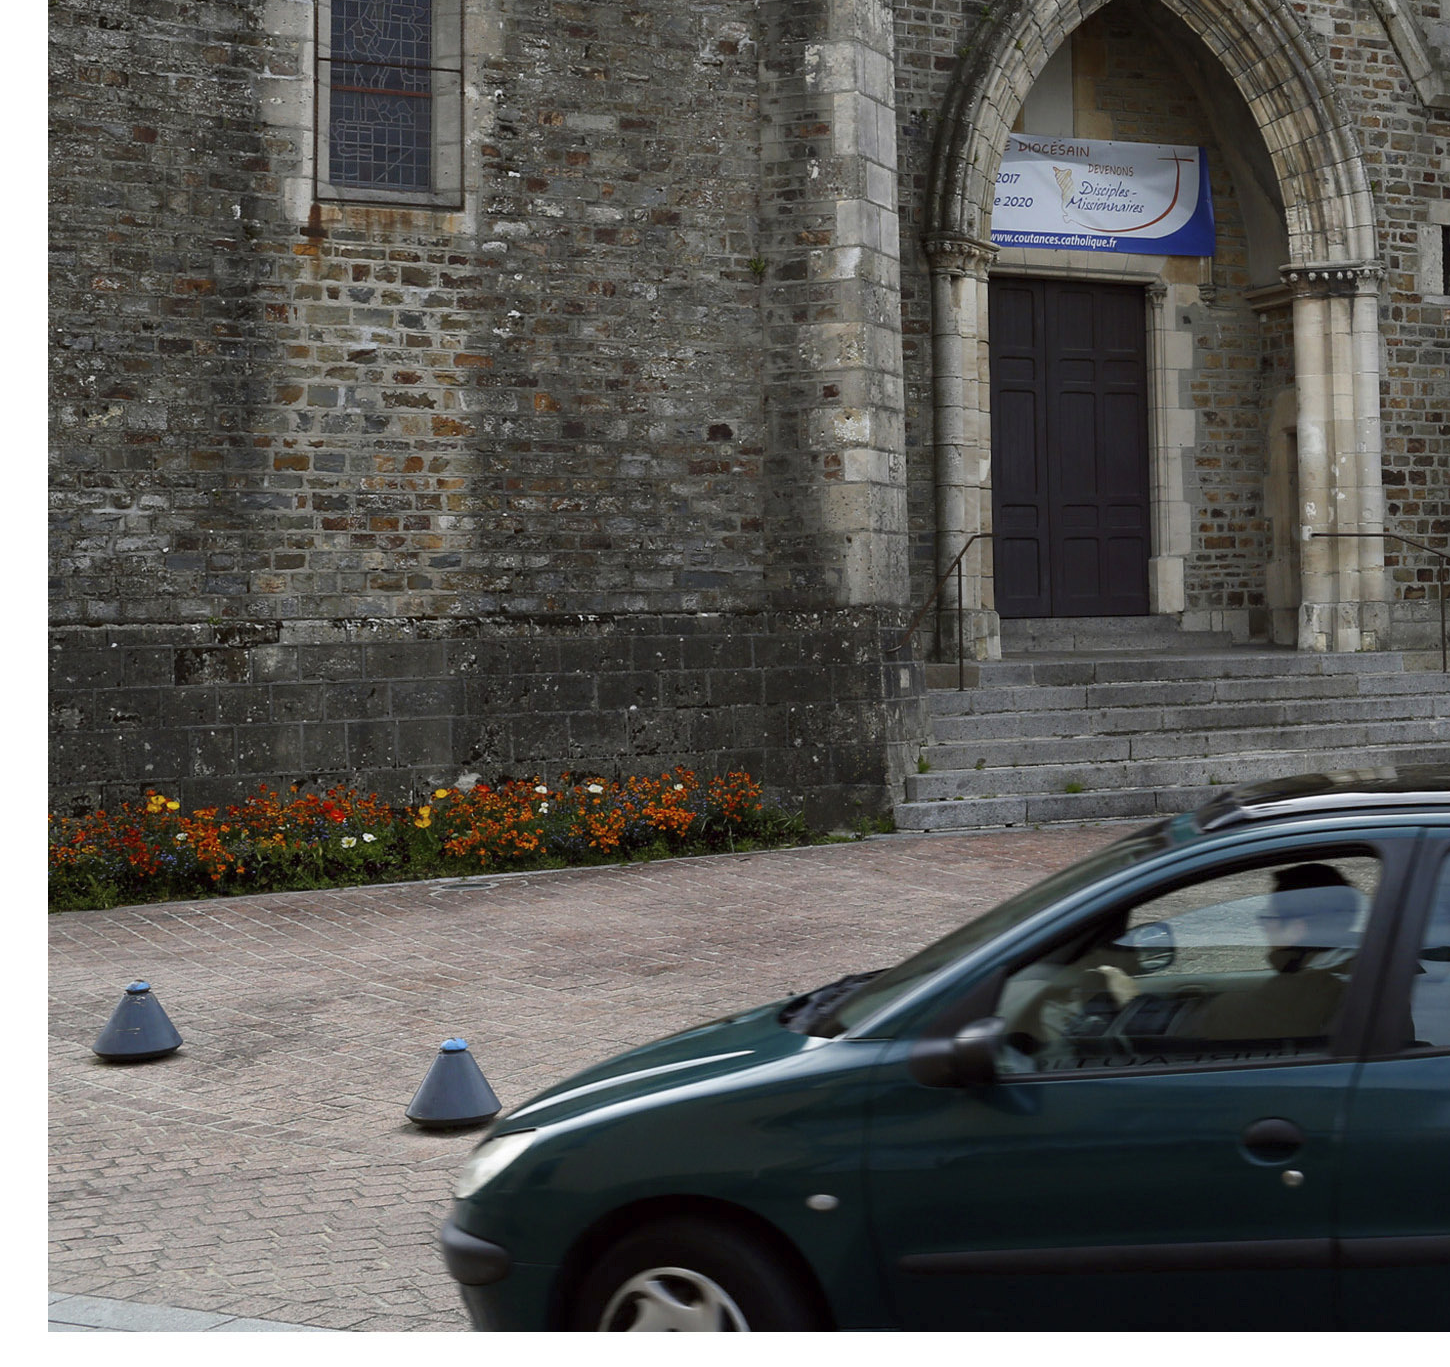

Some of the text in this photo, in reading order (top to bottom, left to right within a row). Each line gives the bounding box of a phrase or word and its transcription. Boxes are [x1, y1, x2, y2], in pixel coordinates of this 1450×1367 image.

[1018, 141, 1090, 157] DIOCÉSAIN
[1088, 163, 1134, 177] DEVENONS
[995, 172, 1021, 184] 2017
[1079, 180, 1130, 201] Disciples
[1003, 196, 1034, 208] 2020
[1065, 195, 1145, 213] Missionnaires
